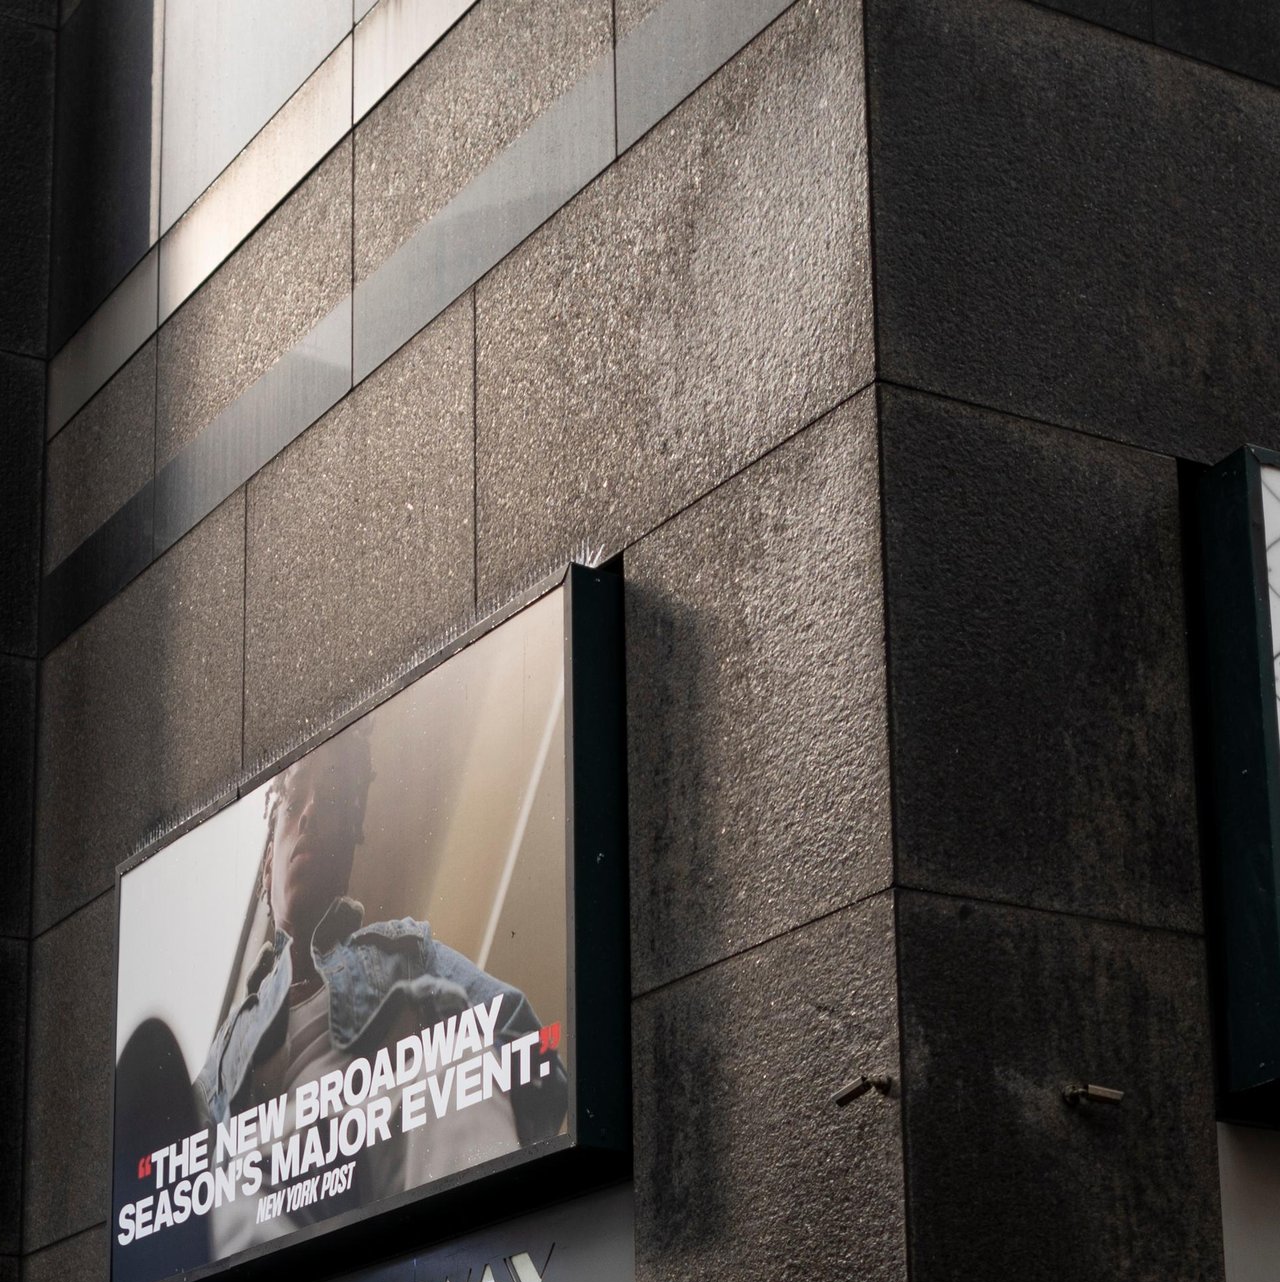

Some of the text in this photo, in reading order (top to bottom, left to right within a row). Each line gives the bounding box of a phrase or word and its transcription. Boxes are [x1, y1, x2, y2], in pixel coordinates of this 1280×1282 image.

[216, 1095, 288, 1162] NEW
[296, 994, 506, 1128] BROADWAY
[272, 1095, 391, 1185] MAJOR
[257, 1162, 356, 1223] NEW YORK POST
